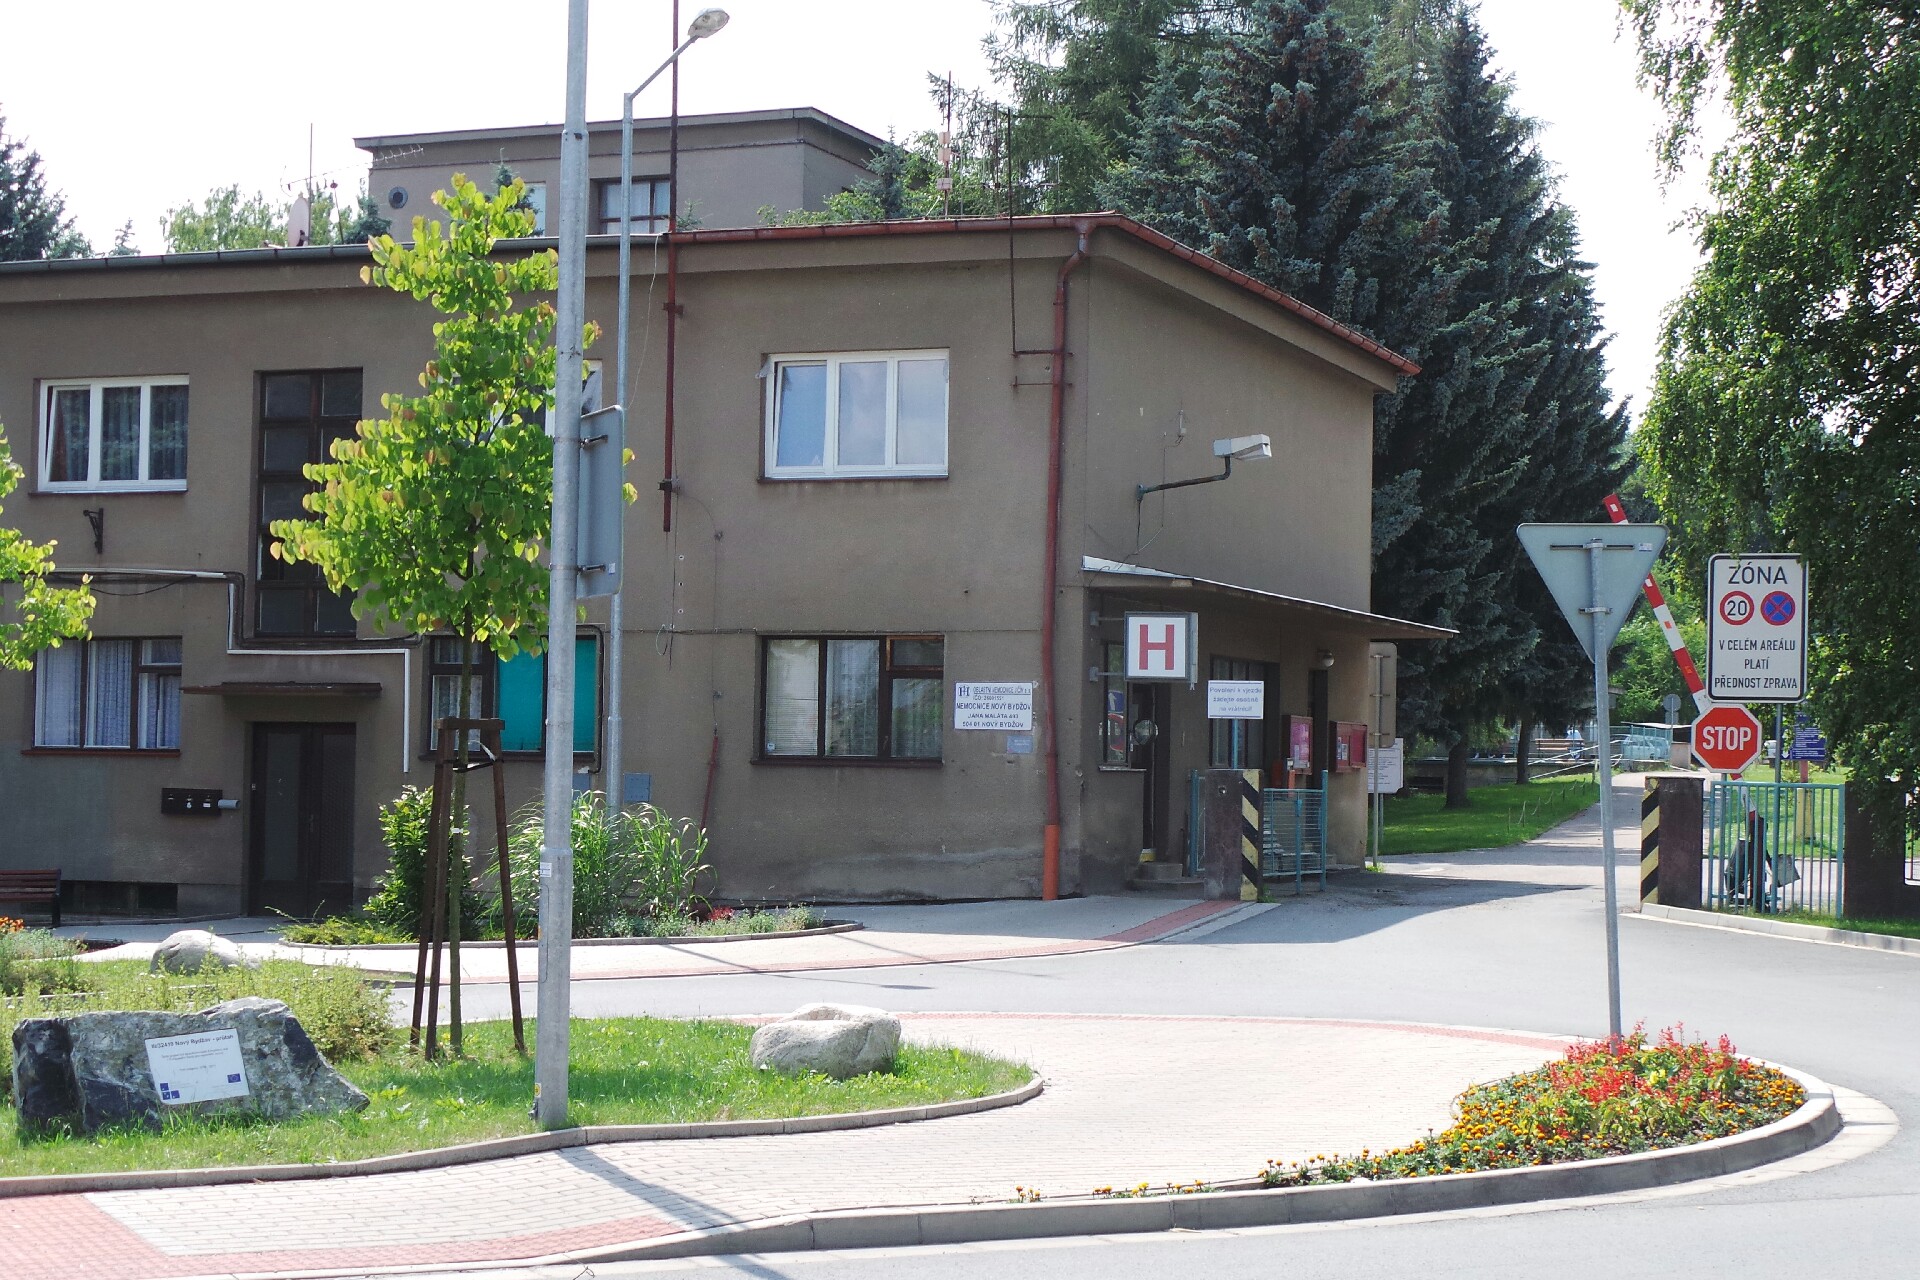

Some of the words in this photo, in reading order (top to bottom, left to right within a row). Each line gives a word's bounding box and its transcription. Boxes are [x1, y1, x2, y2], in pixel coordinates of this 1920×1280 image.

[1728, 562, 1788, 585] ZÓNA
[1727, 600, 1748, 616] 20
[1139, 624, 1175, 670] H
[1719, 640, 1725, 650] V
[1728, 638, 1757, 651] CELÉM
[1760, 638, 1796, 651] AREÁLU
[1744, 657, 1769, 670] PLATÍ
[1714, 675, 1761, 688] PŘEDNOST
[1763, 677, 1798, 689] ZPRAVA
[956, 702, 990, 710] NEMOCNICE
[991, 702, 1006, 710] NOVÝ
[1008, 702, 1031, 711] BYDŽOV
[1000, 720, 1024, 728] BYDŽOV
[1702, 726, 1752, 751] STOP
